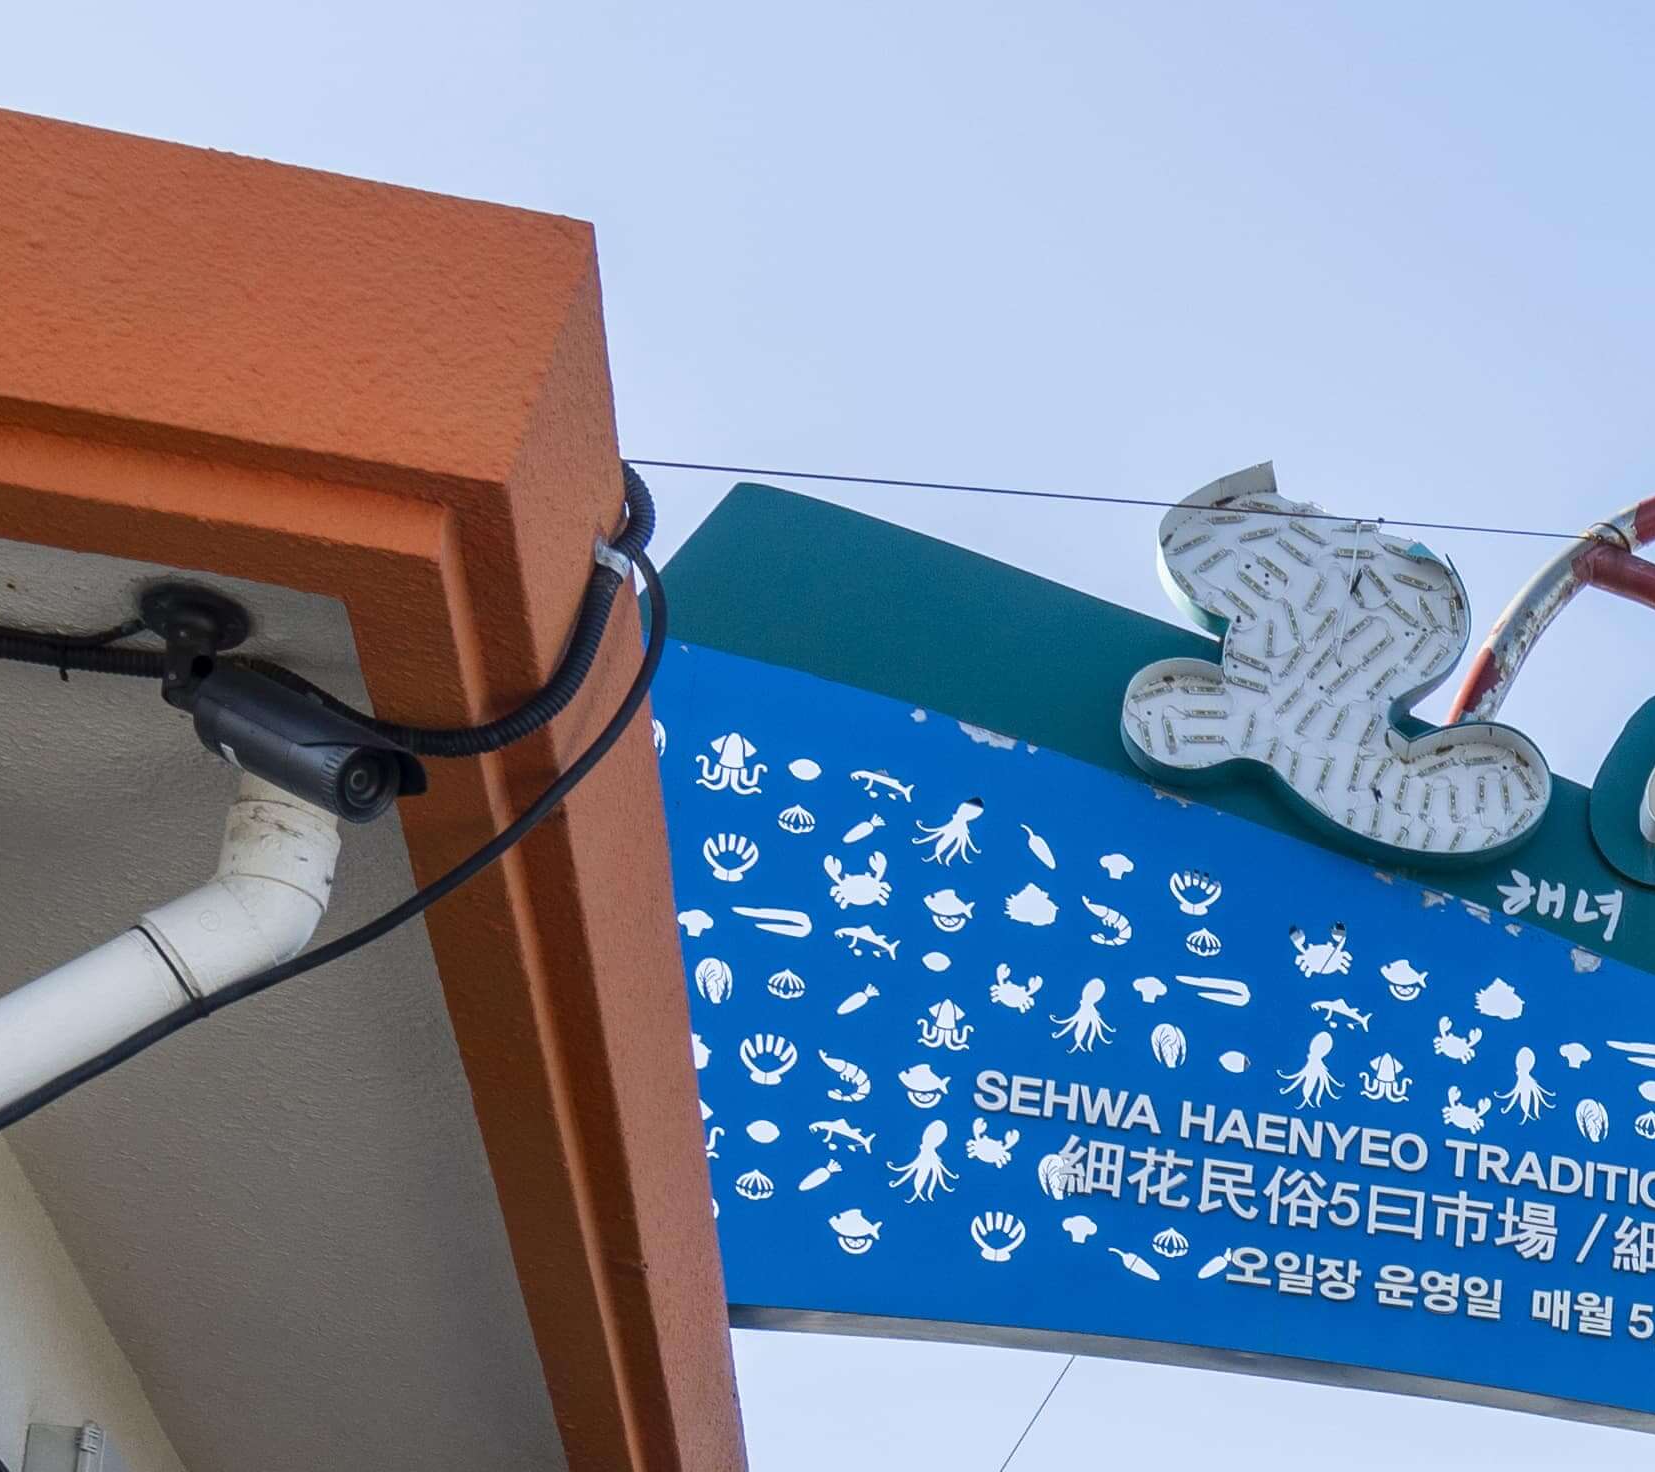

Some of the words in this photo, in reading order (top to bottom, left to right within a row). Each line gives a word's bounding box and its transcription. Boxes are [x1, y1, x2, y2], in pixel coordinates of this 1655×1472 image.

[1497, 869, 1623, 942] 해녀
[974, 1069, 1162, 1134] SEHWA
[1180, 1100, 1429, 1173] HAENYEO
[1226, 1245, 1362, 1301] 오일장
[1374, 1261, 1503, 1320] 운영일
[1531, 1287, 1614, 1338] 매월
